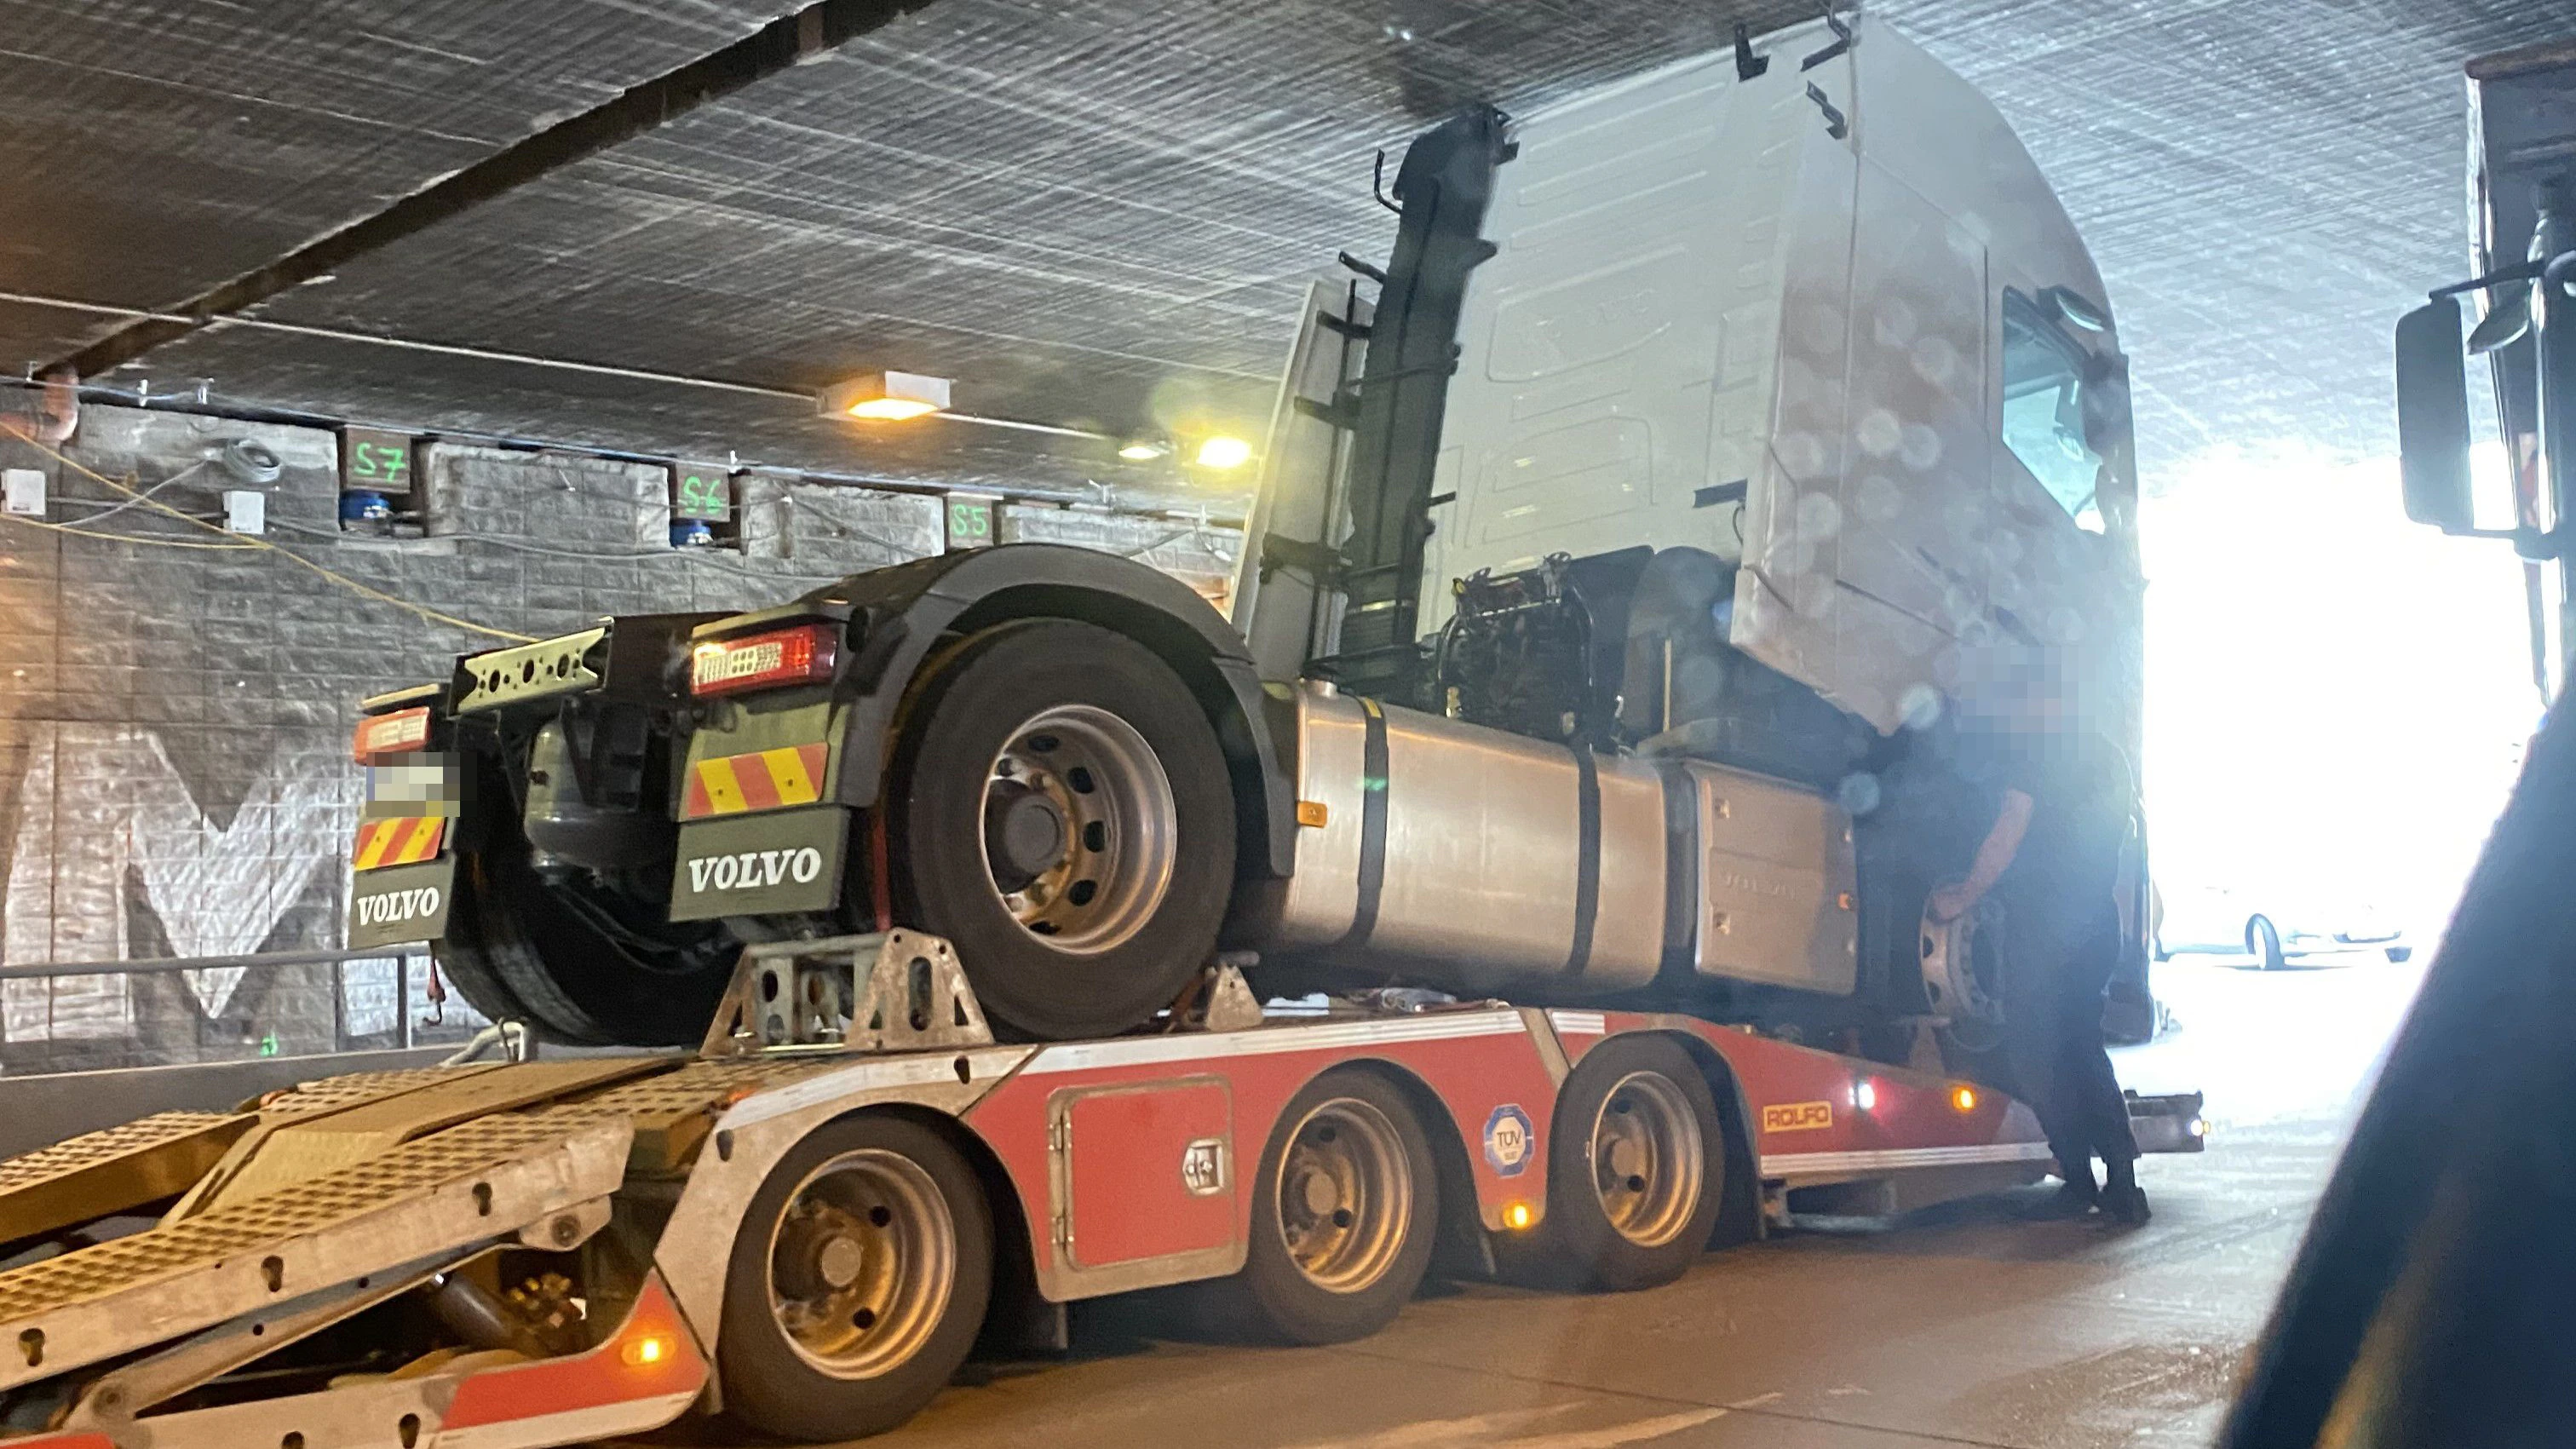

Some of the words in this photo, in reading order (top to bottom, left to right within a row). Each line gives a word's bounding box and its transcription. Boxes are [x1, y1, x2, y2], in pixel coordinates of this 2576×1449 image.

[354, 442, 405, 483] S7
[679, 475, 722, 514] S6
[953, 503, 986, 536] S5
[688, 847, 821, 893] VOLVO
[357, 886, 440, 926] VOLVO
[1767, 1107, 1829, 1126] ROLFO
